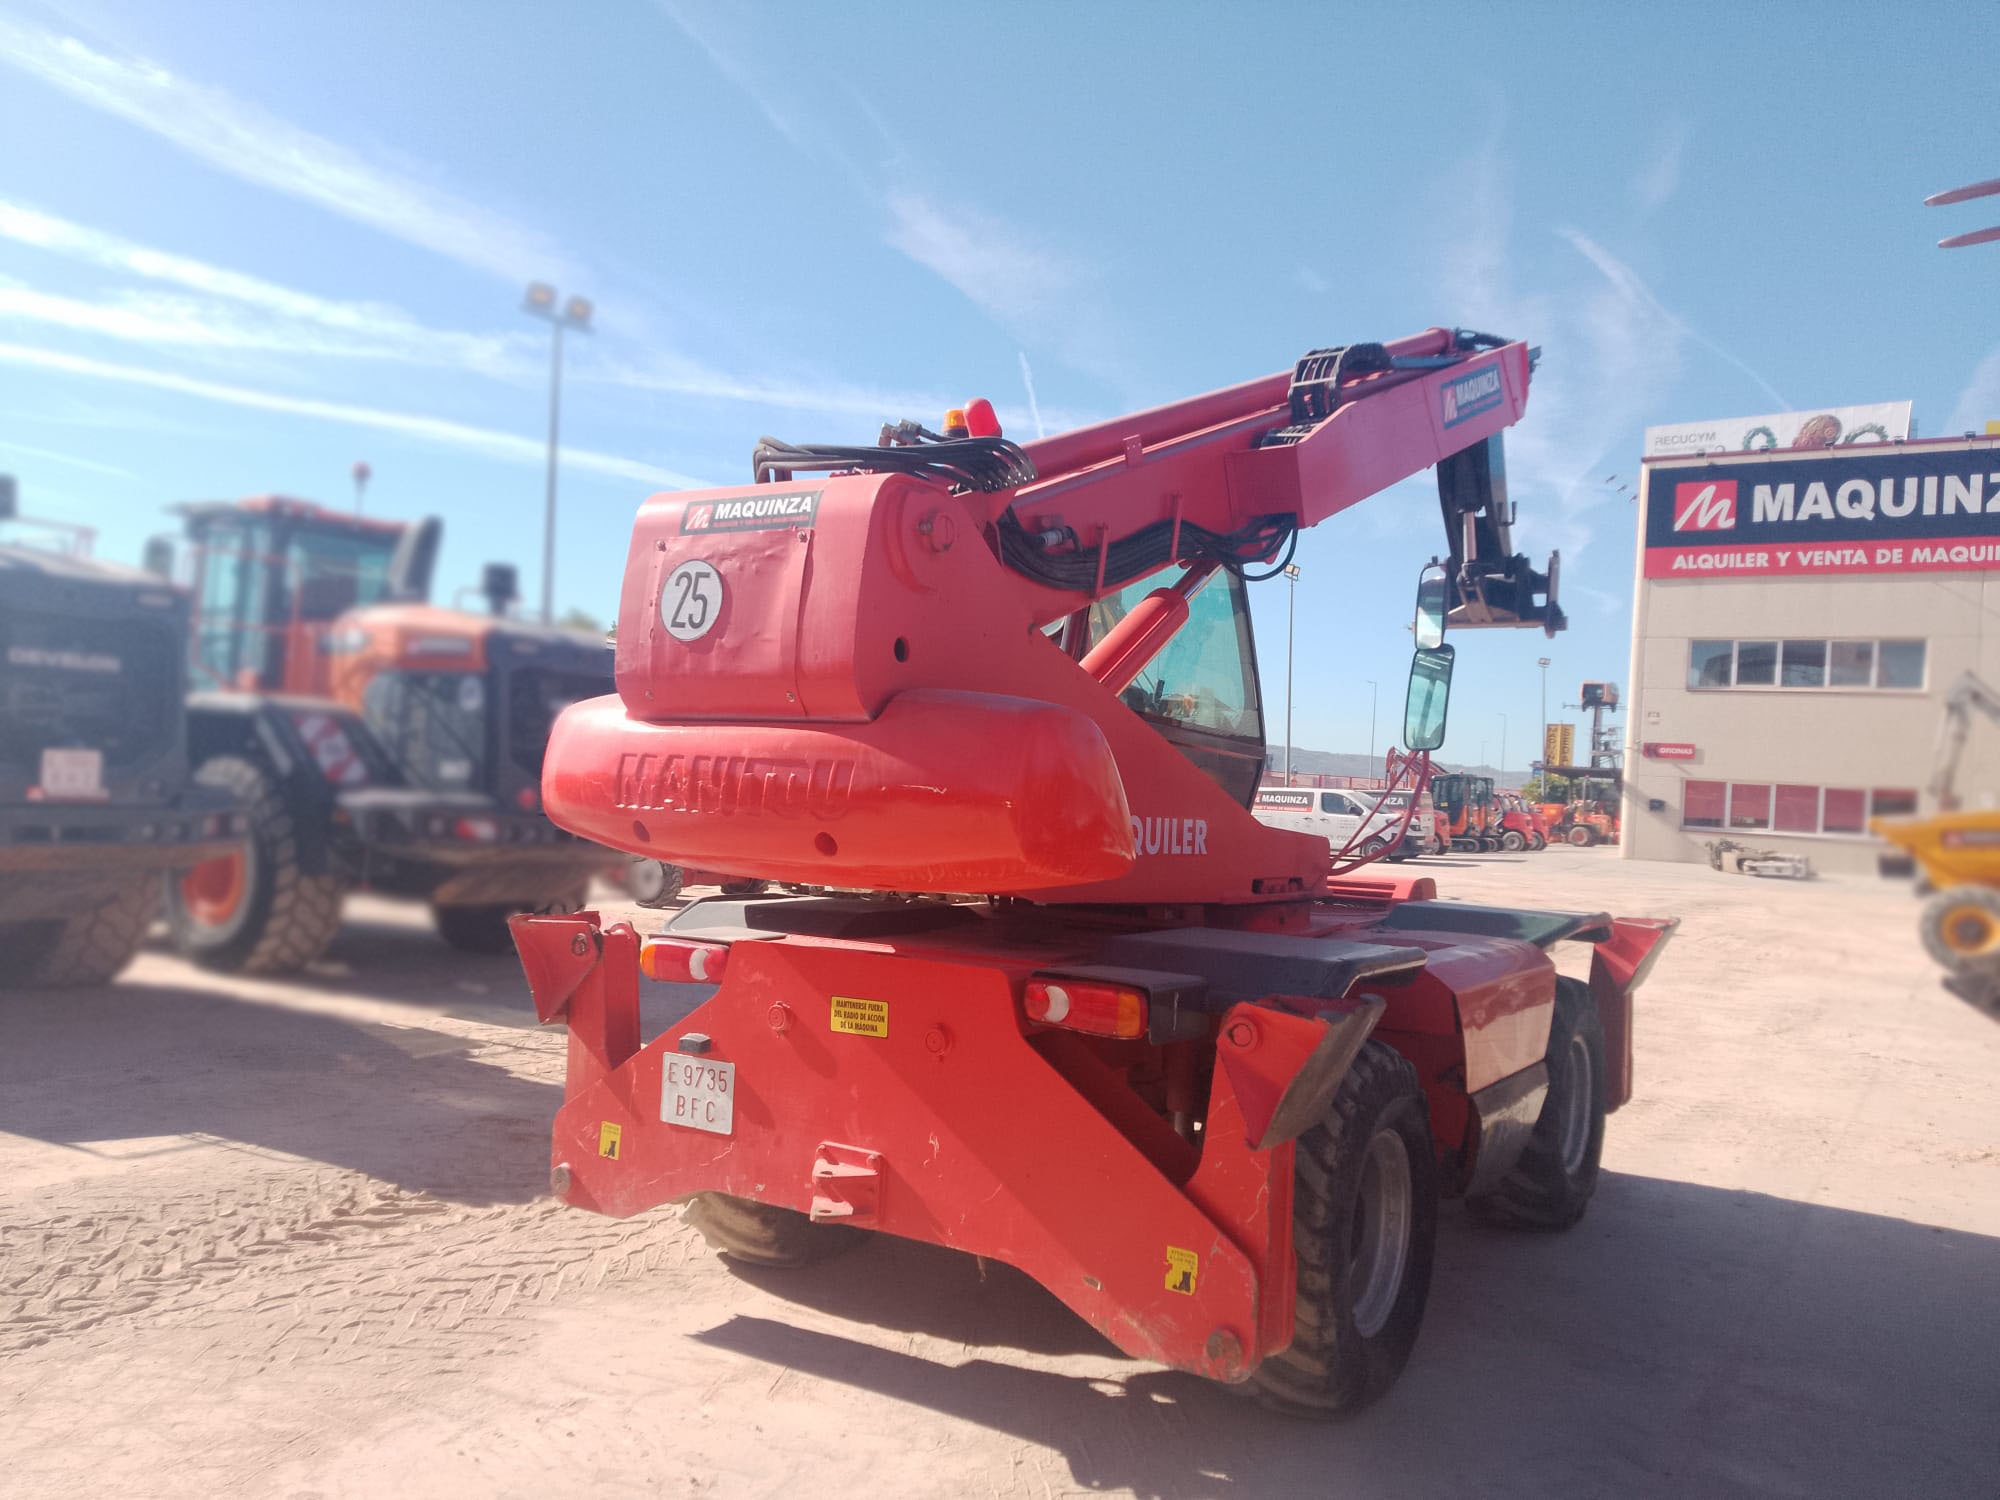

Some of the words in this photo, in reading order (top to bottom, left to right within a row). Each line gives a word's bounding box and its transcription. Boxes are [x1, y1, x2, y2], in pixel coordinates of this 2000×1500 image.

[1655, 431, 1717, 446] RECUCYM
[715, 496, 812, 520] MAQUINZA
[1672, 552, 1769, 570] ALQUILER
[1776, 551, 1791, 567] Y
[1797, 549, 1868, 566] VENTA
[1876, 548, 1904, 564] DE
[670, 571, 711, 630] 25
[615, 752, 857, 821] MANITOU
[1261, 794, 1308, 804] MAQUINZA
[834, 1009, 843, 1018] DEL
[844, 1010, 859, 1020] RADIO
[860, 1013, 866, 1021] DE
[836, 1000, 867, 1011] MANTENERSE
[868, 1003, 884, 1012] FUERA
[840, 1021, 846, 1029] DE
[848, 1022, 853, 1030] LA
[683, 1064, 728, 1093] 9735
